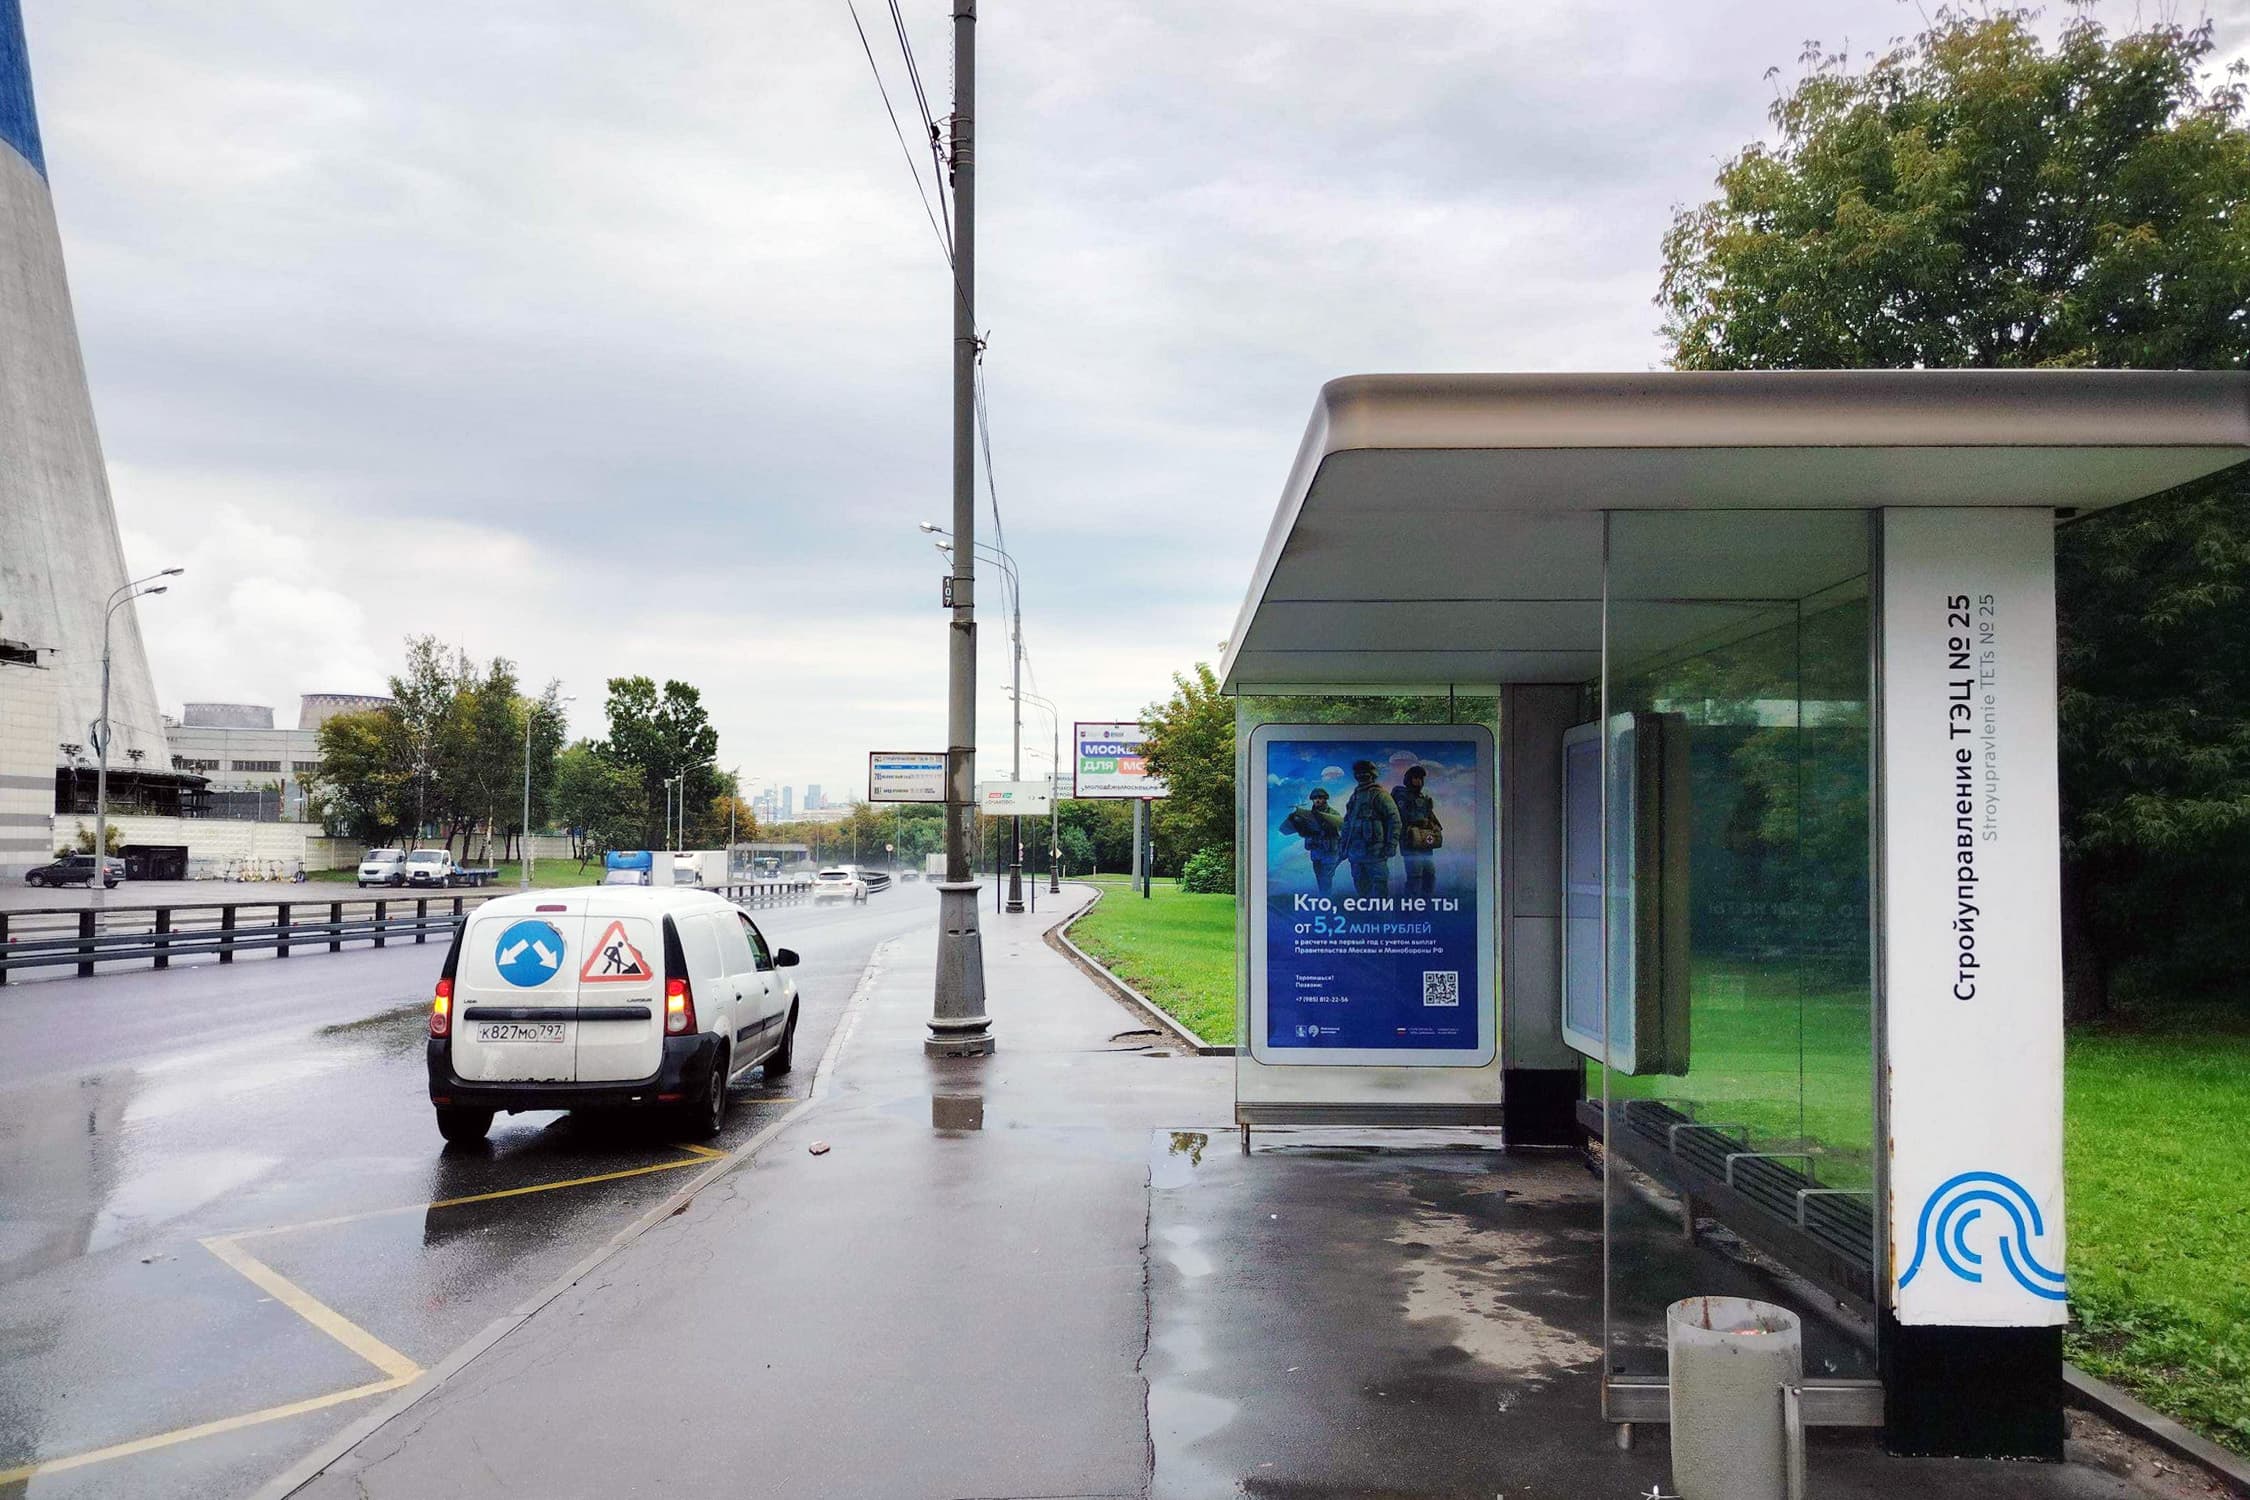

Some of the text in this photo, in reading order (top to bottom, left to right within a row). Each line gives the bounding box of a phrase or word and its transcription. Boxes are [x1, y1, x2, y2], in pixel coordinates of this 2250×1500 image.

[1979, 594, 2000, 841] Stroyupravlenie TETs № 25
[1083, 761, 1114, 772] ДЛЯ
[1947, 594, 1980, 1001] Стройуправление ТЭЦ № 25
[1294, 893, 1459, 914] Кто, если не ты
[1294, 915, 1432, 936] от 5,2 МЛН РУБЛЕЙ
[1338, 938, 1366, 947] первый
[1385, 939, 1411, 947] учетом
[481, 1025, 561, 1040] К827МО 797
